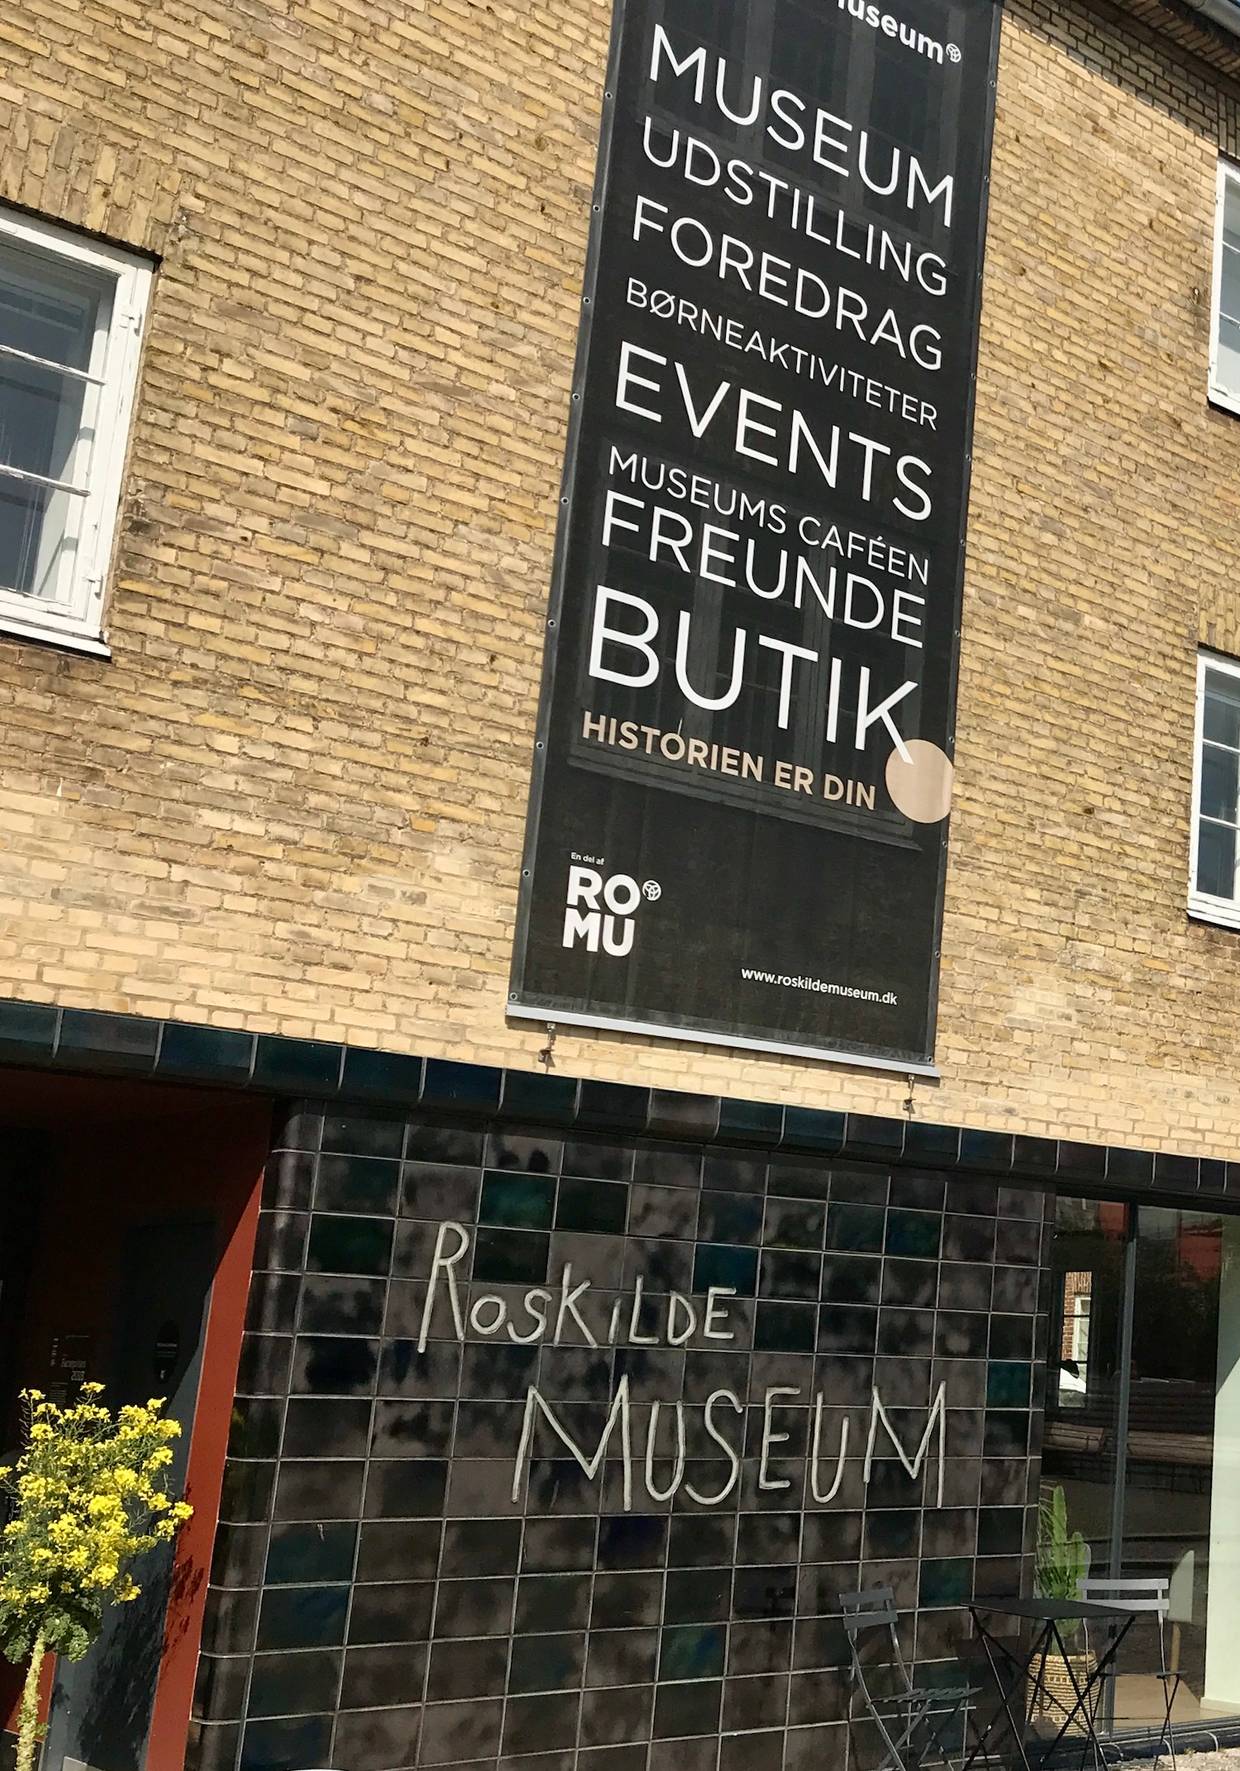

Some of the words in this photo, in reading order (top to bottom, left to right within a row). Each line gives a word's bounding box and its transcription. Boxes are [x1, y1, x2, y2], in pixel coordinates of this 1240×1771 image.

[838, 0, 943, 64] useum
[650, 24, 954, 228] MUSEUM
[643, 116, 947, 296] UDSTILLING
[633, 195, 942, 371] FOREDRAG
[626, 277, 937, 431] BØRNEAKTIVITETER
[615, 341, 932, 521] EVENTS
[601, 490, 926, 649] FREUNDE
[608, 446, 787, 534] MUSEUMS
[798, 516, 929, 586] CAFÉEN
[588, 585, 919, 765] BUTIK
[582, 711, 764, 783] HISTORIEN
[774, 761, 814, 796] ER
[823, 773, 876, 811] DIN
[566, 865, 641, 916] RO
[570, 852, 582, 861] En
[582, 854, 595, 864] del
[595, 857, 605, 866] af
[562, 907, 636, 957] MU
[741, 967, 898, 1006] www.roskildemuseum.dk
[511, 1373, 947, 1512] MUSEUM
